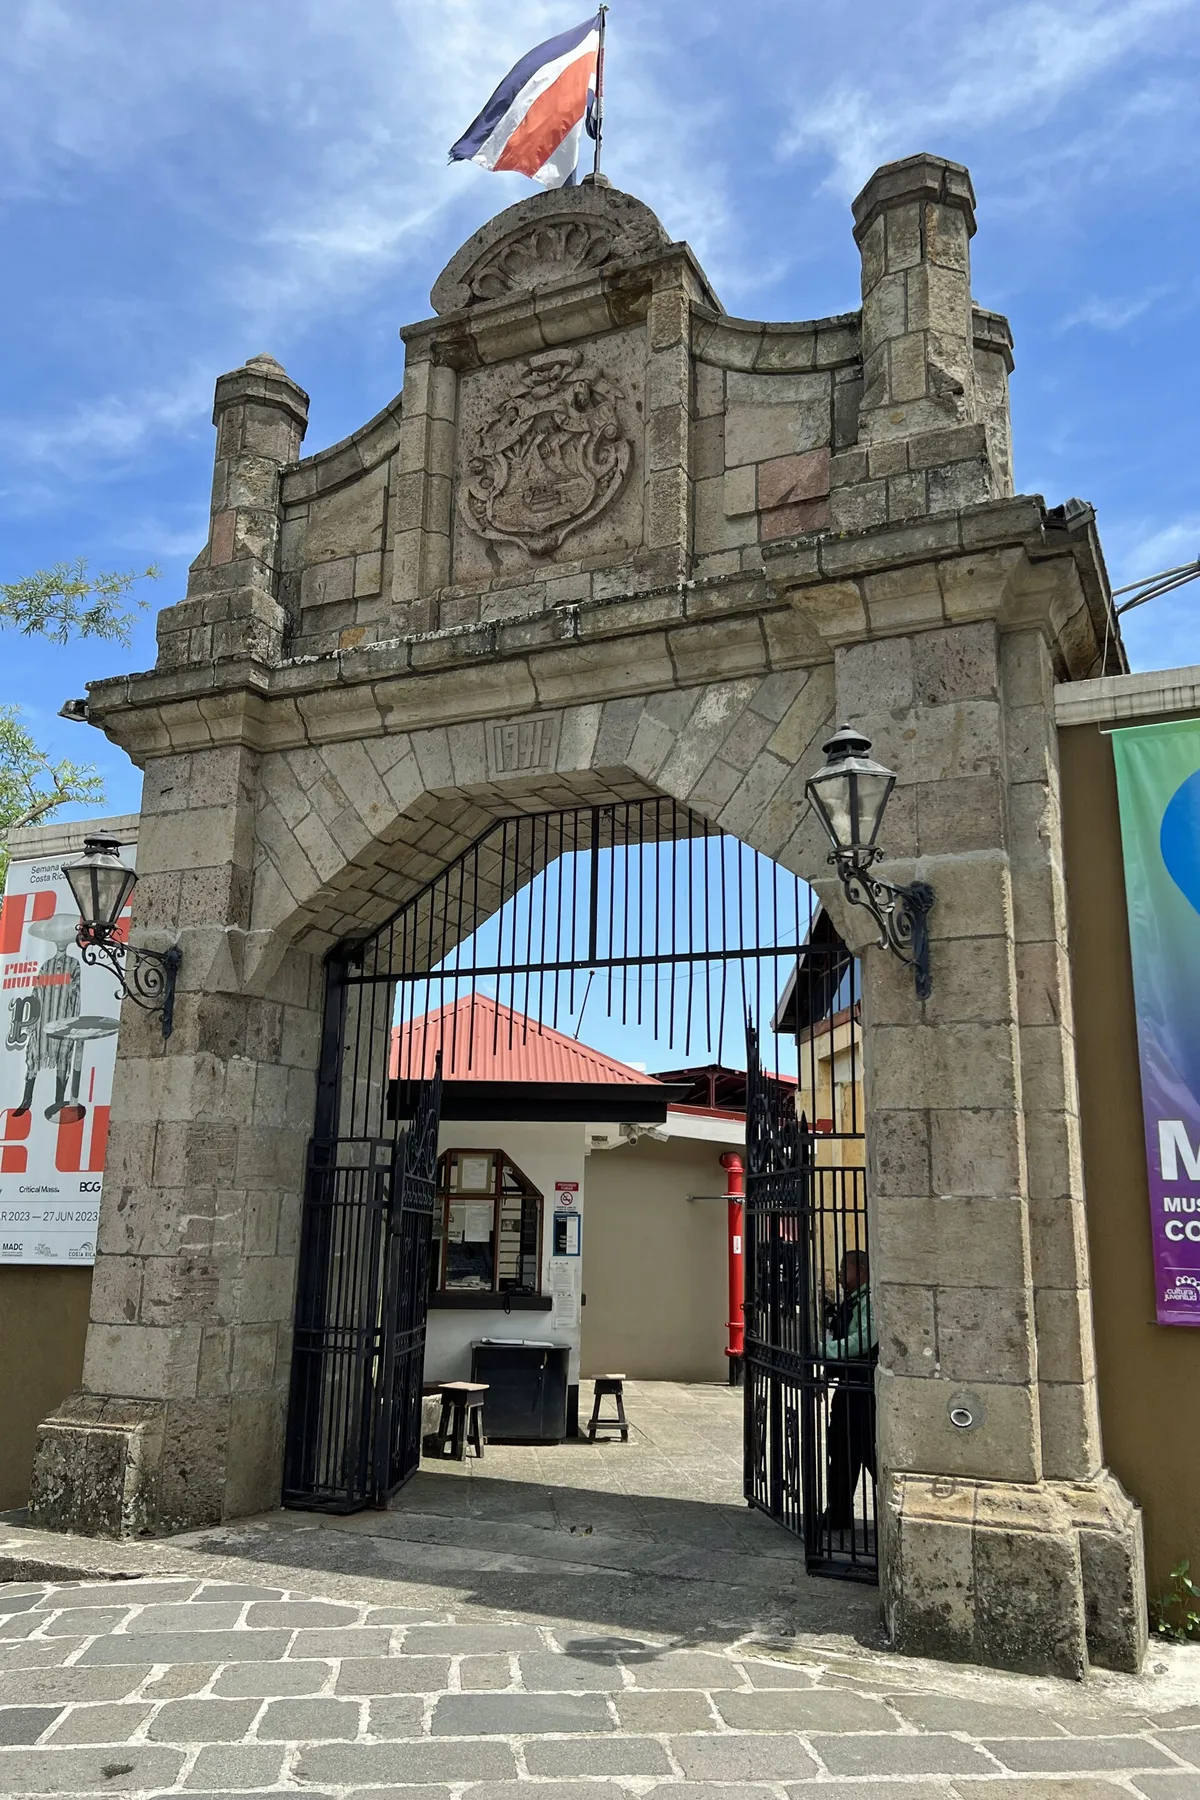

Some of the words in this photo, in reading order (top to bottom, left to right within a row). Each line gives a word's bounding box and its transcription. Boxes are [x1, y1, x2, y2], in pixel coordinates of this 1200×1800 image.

[31, 865, 60, 875] Semana
[29, 874, 50, 884] Costa
[79, 1182, 101, 1192] BCG
[8, 1211, 30, 1221] 2023
[43, 1211, 55, 1221] 27
[55, 1211, 73, 1221] JUN
[75, 1211, 98, 1221] 2023
[2, 1243, 23, 1251] MADC
